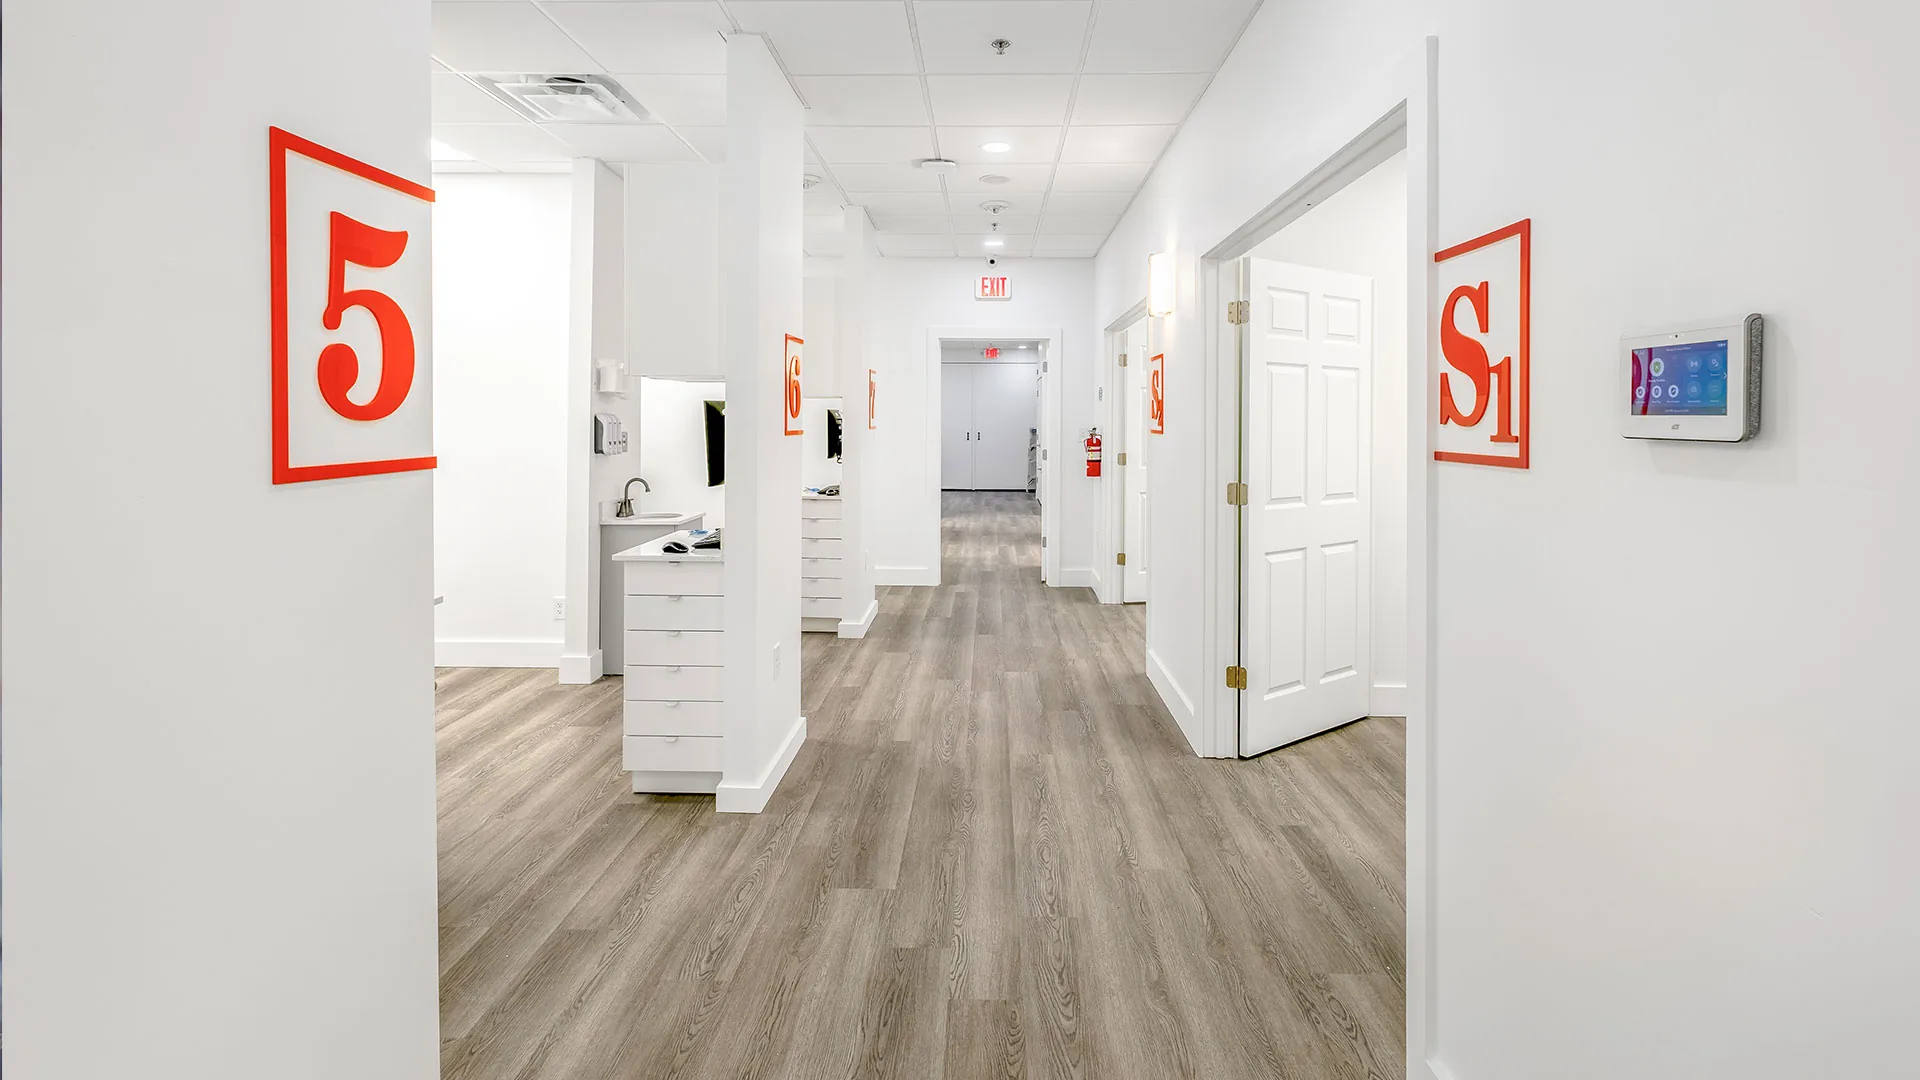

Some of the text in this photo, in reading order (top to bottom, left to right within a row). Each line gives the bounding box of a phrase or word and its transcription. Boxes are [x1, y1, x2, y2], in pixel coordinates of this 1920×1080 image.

[317, 211, 415, 421] 5
[981, 277, 1007, 297] EXIT
[788, 354, 801, 419] 6
[1439, 280, 1519, 443] S1
